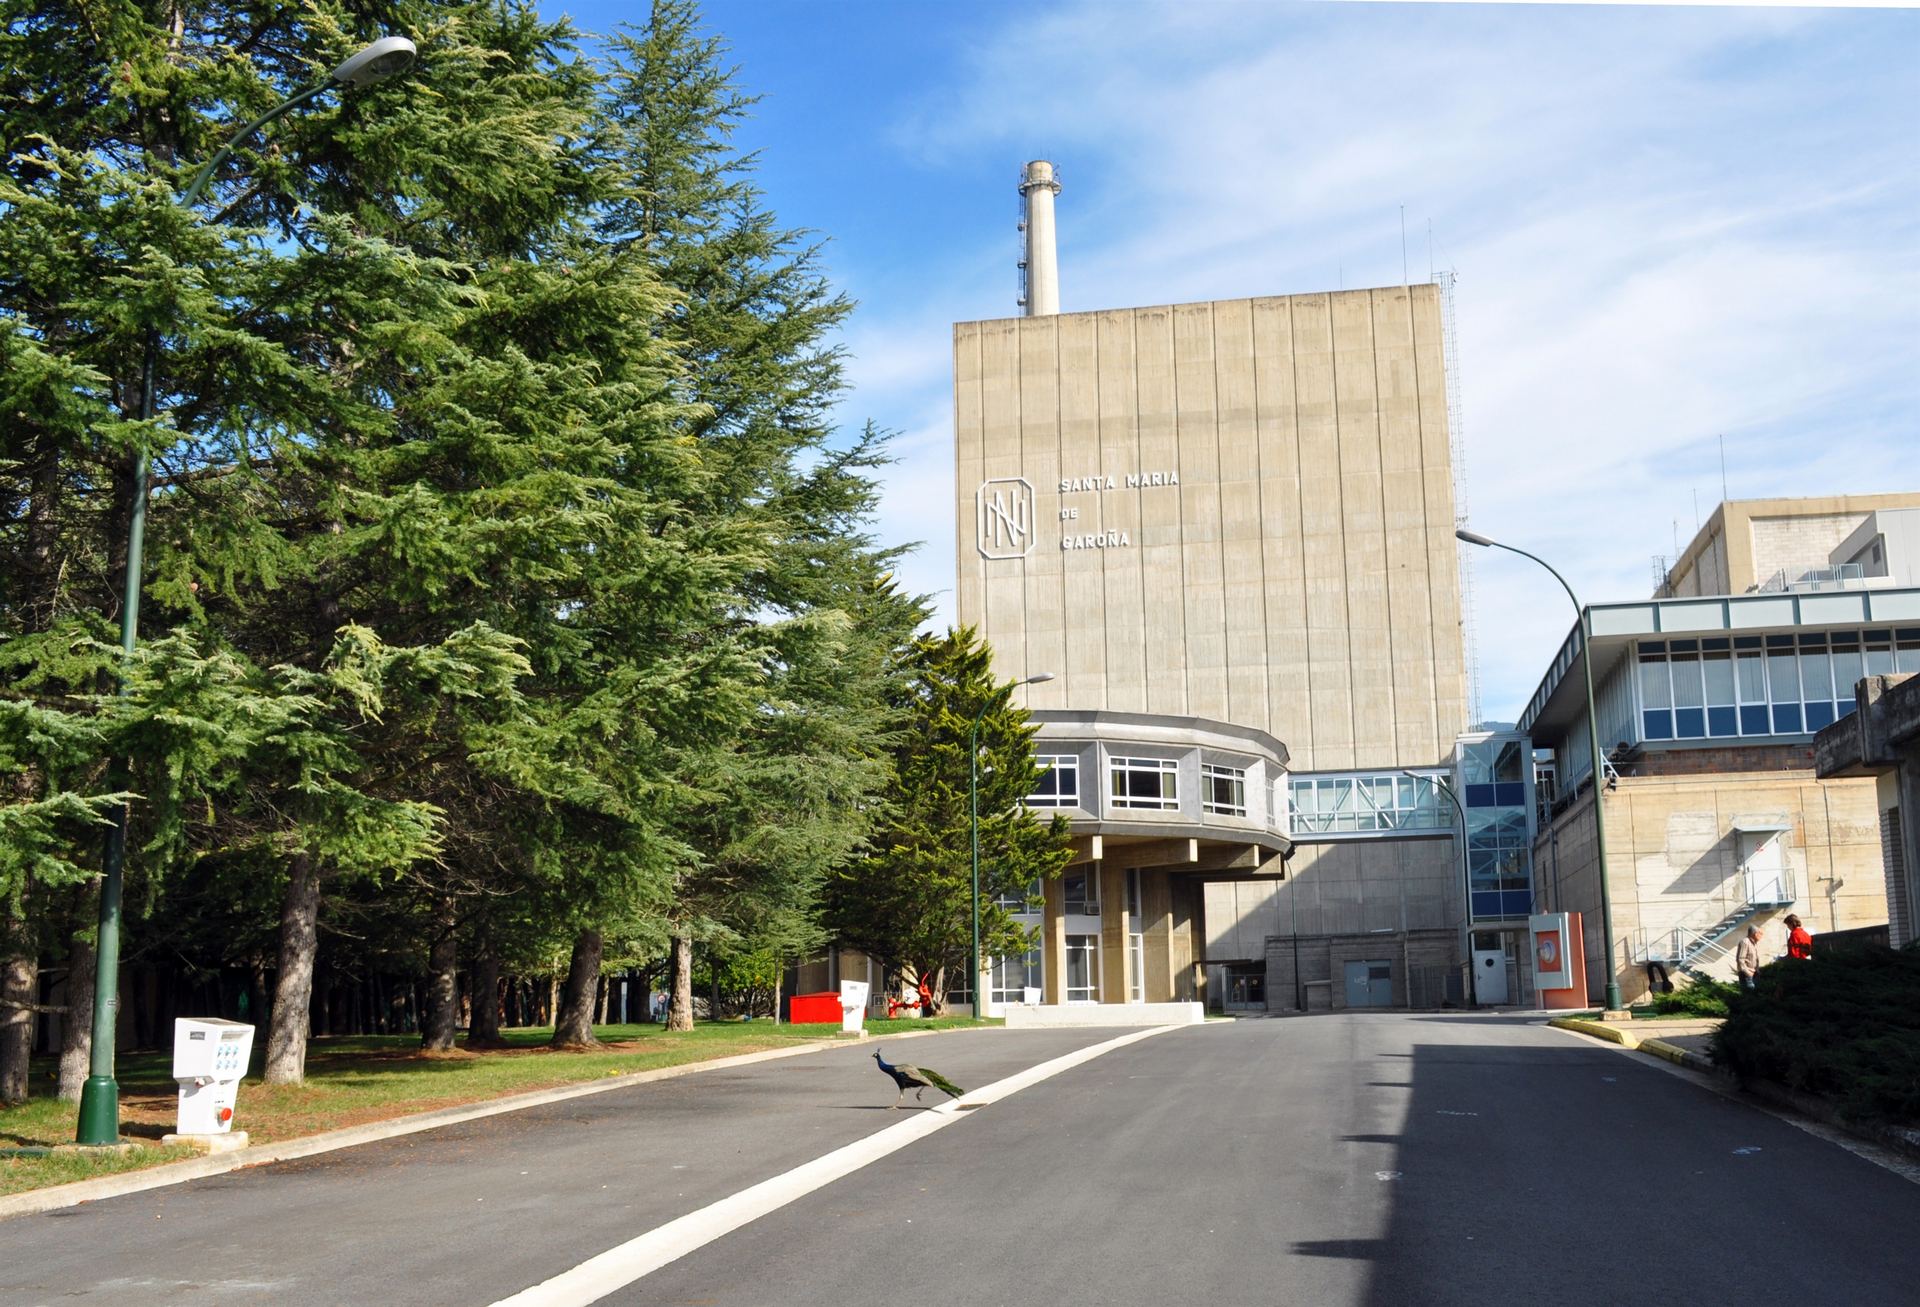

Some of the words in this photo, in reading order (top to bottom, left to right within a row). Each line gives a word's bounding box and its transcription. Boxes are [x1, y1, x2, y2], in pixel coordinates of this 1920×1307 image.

[1060, 475, 1116, 492] SANTA
[1126, 471, 1179, 488] MARIA
[1060, 507, 1079, 520] DE
[1061, 529, 1129, 550] GAROÑA
